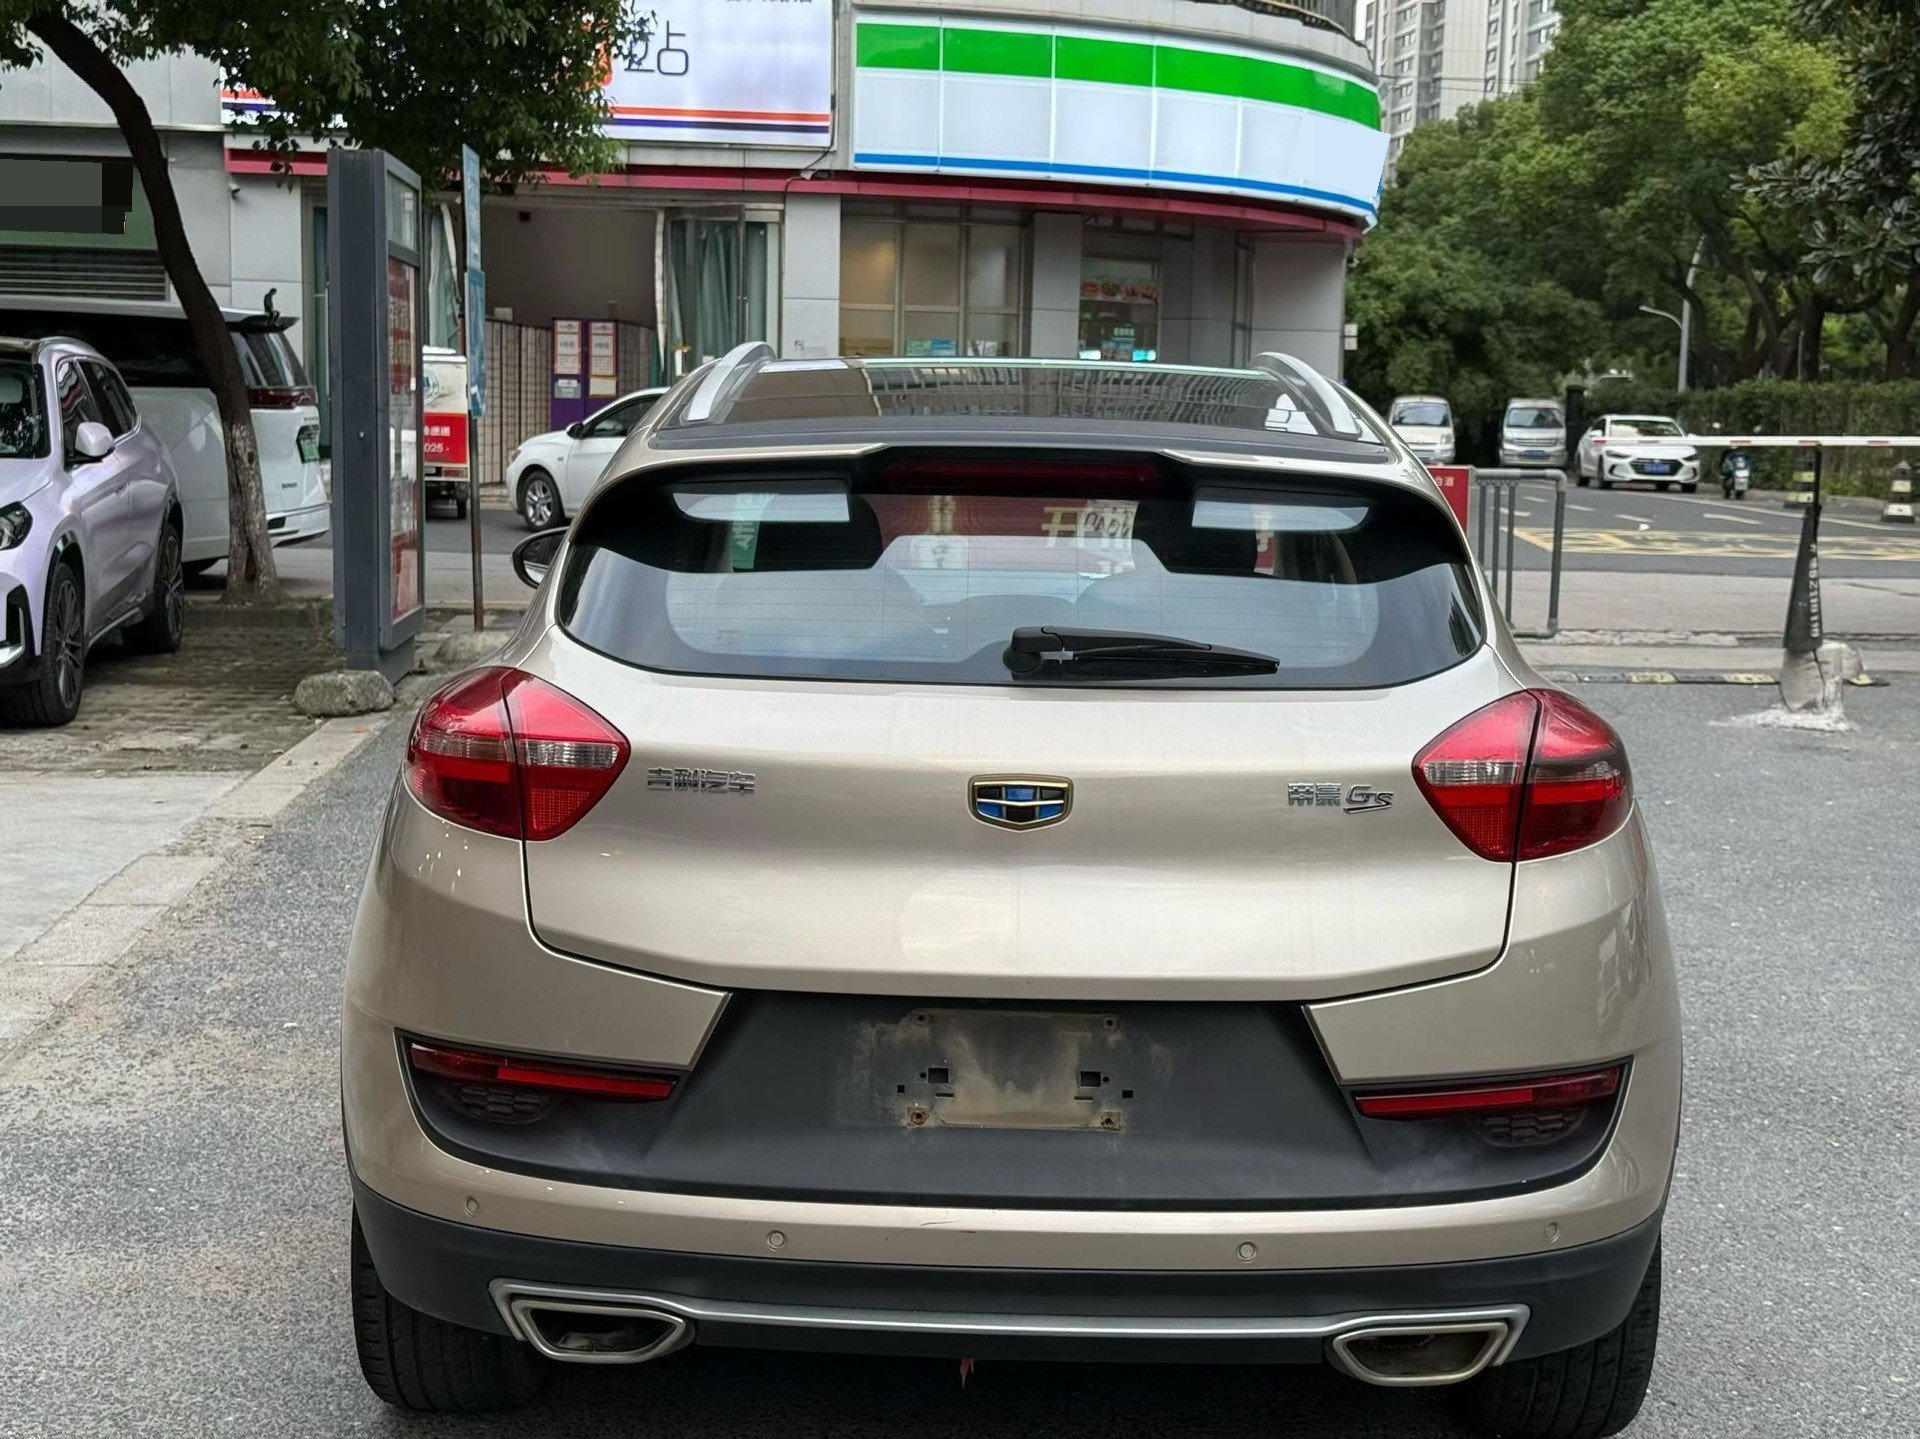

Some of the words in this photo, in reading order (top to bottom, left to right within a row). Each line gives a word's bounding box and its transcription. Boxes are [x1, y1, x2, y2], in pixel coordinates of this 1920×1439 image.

[648, 767, 755, 794] 吉利汽车
[1287, 782, 1341, 806] 帝豪
